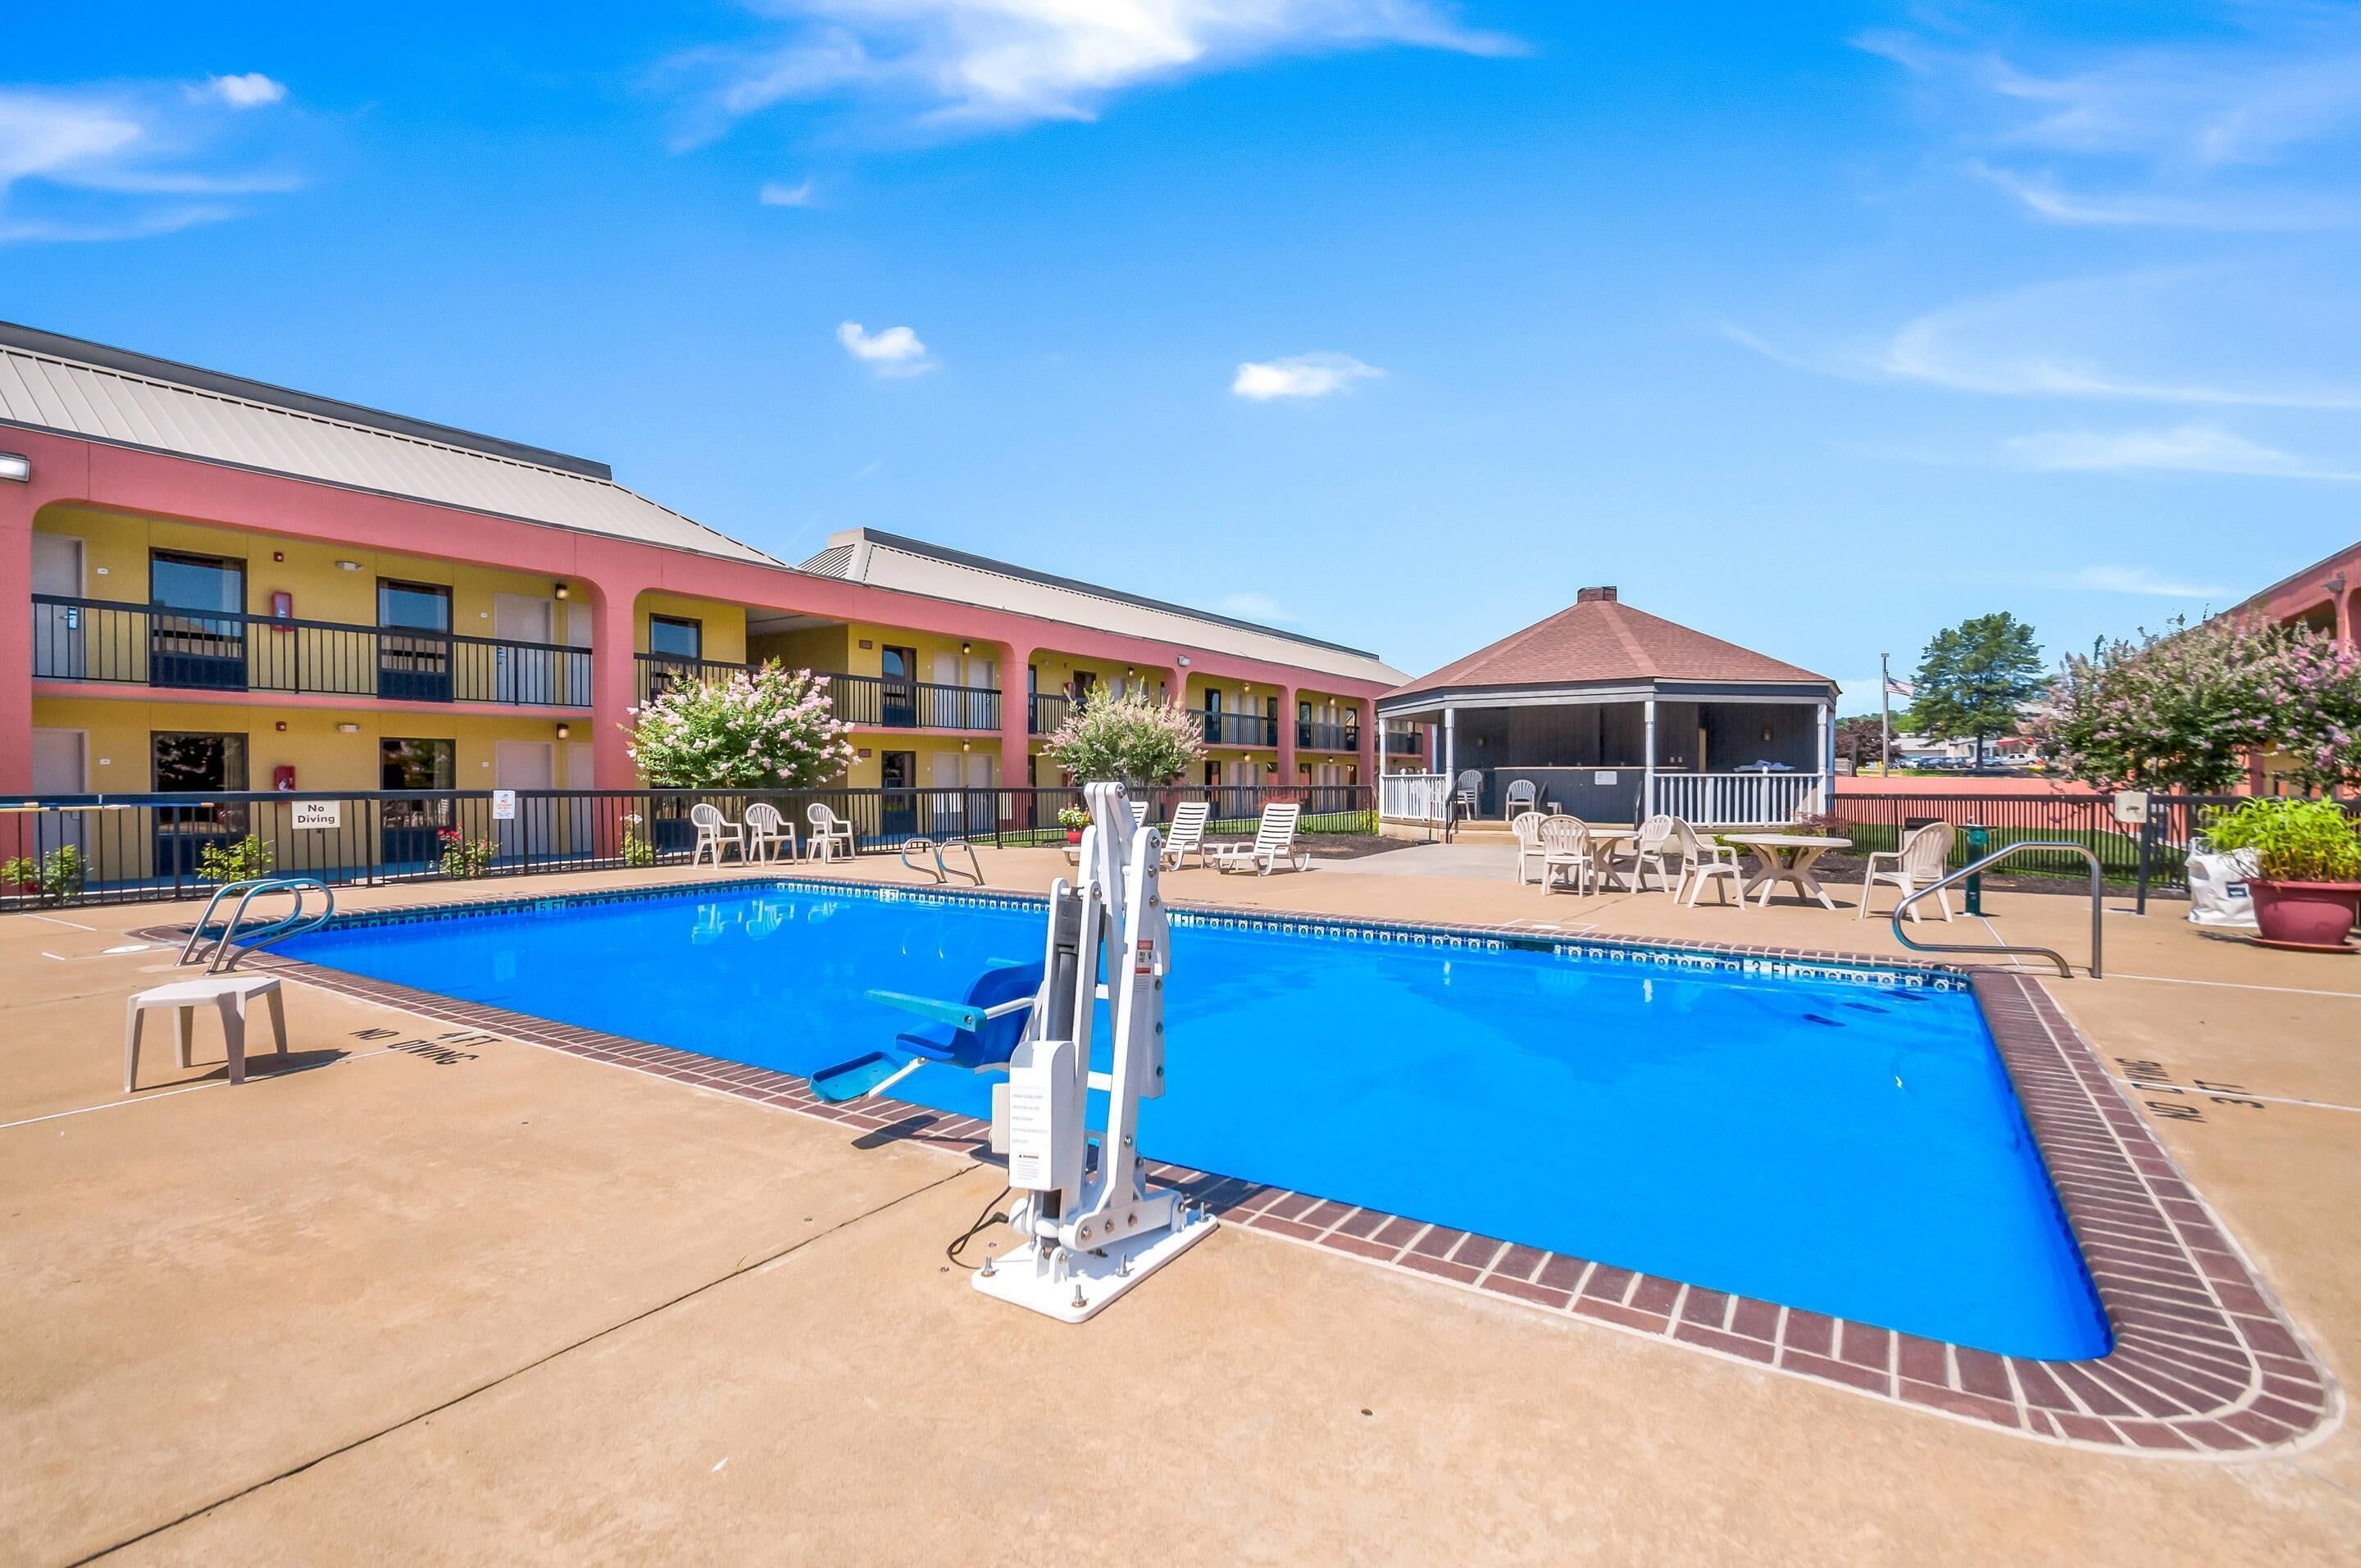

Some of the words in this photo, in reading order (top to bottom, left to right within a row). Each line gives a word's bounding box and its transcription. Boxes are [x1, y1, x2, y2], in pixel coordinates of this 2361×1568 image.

[307, 804, 325, 812] No
[298, 815, 335, 825] Diving
[539, 902, 546, 911] 5
[552, 901, 564, 912] FT
[1772, 961, 1791, 975] FT
[348, 1028, 401, 1041] NO
[386, 1039, 480, 1065] DIVING
[450, 1035, 503, 1048] FT
[2114, 1057, 2185, 1095] DIVING
[2192, 1079, 2253, 1096] FT
[2209, 1096, 2266, 1109] 3
[2145, 1101, 2208, 1124] NO
